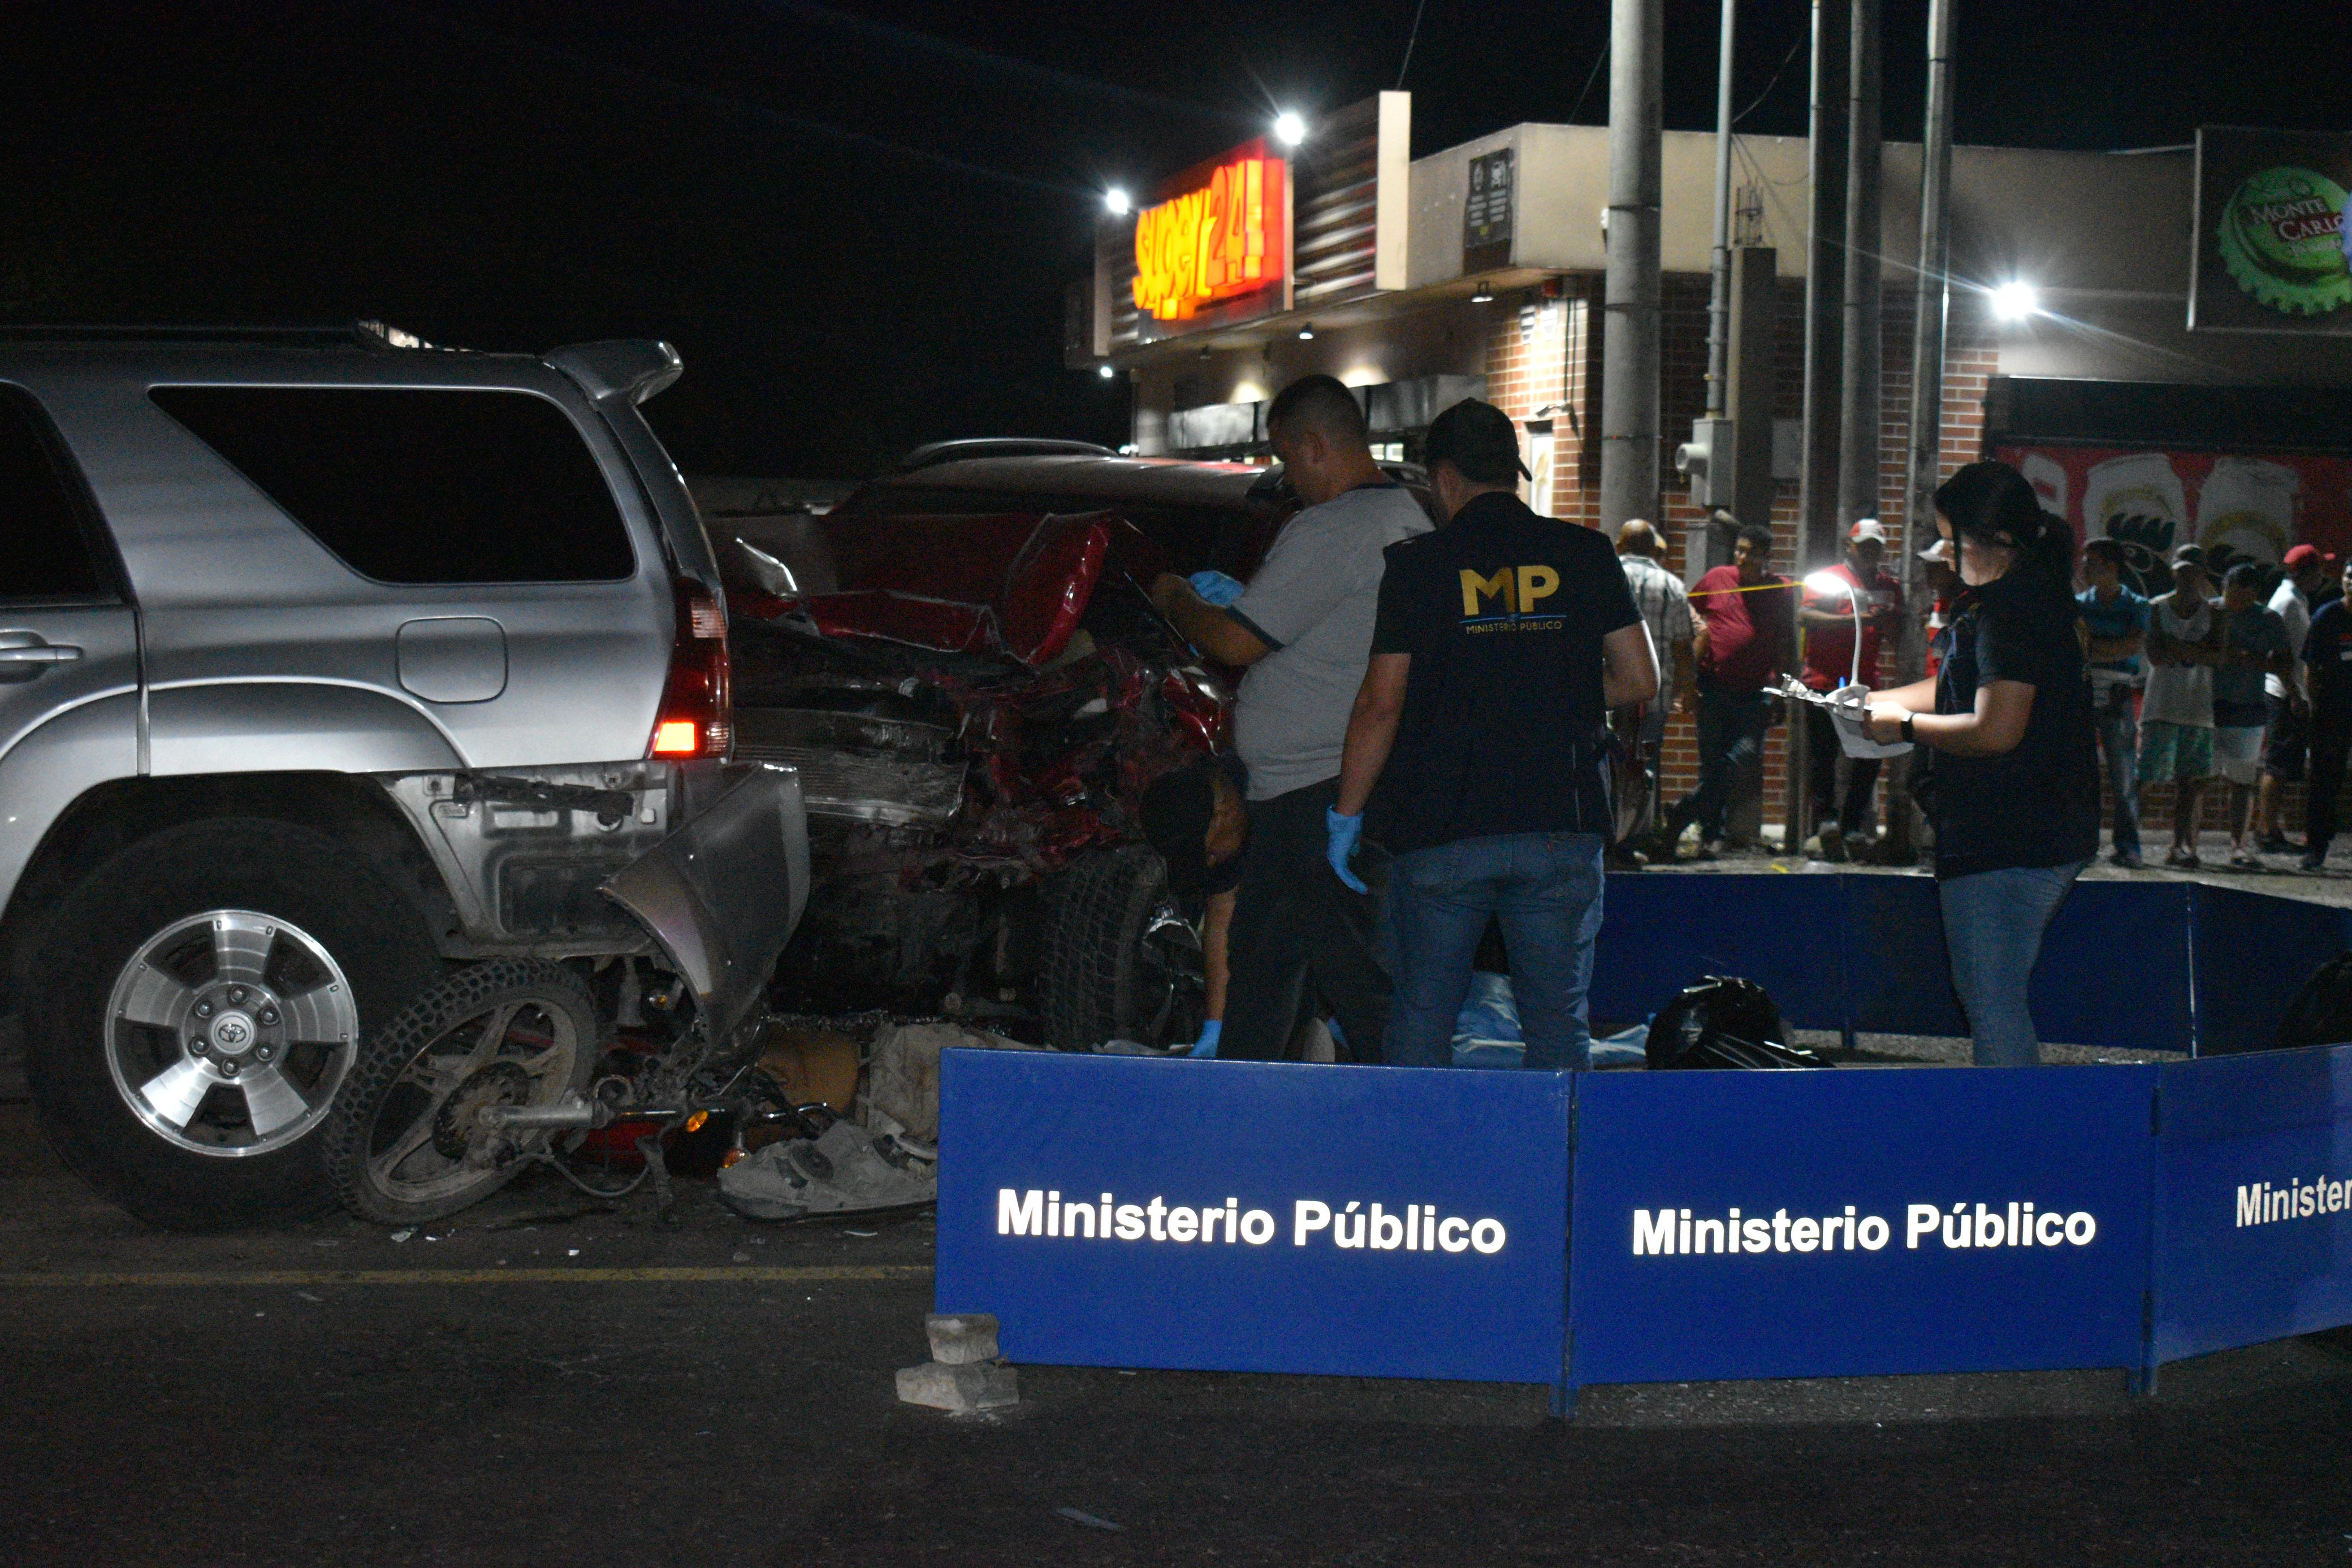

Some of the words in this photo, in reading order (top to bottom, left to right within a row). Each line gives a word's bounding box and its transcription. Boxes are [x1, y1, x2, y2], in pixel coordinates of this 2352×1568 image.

[1459, 565, 1560, 616] MP
[1466, 622, 1517, 635] MINISTERIO
[997, 1189, 1275, 1245] Ministerio
[1294, 1199, 1506, 1254] Público
[1633, 1205, 1890, 1255] Ministerio
[1906, 1202, 2096, 1249] Público
